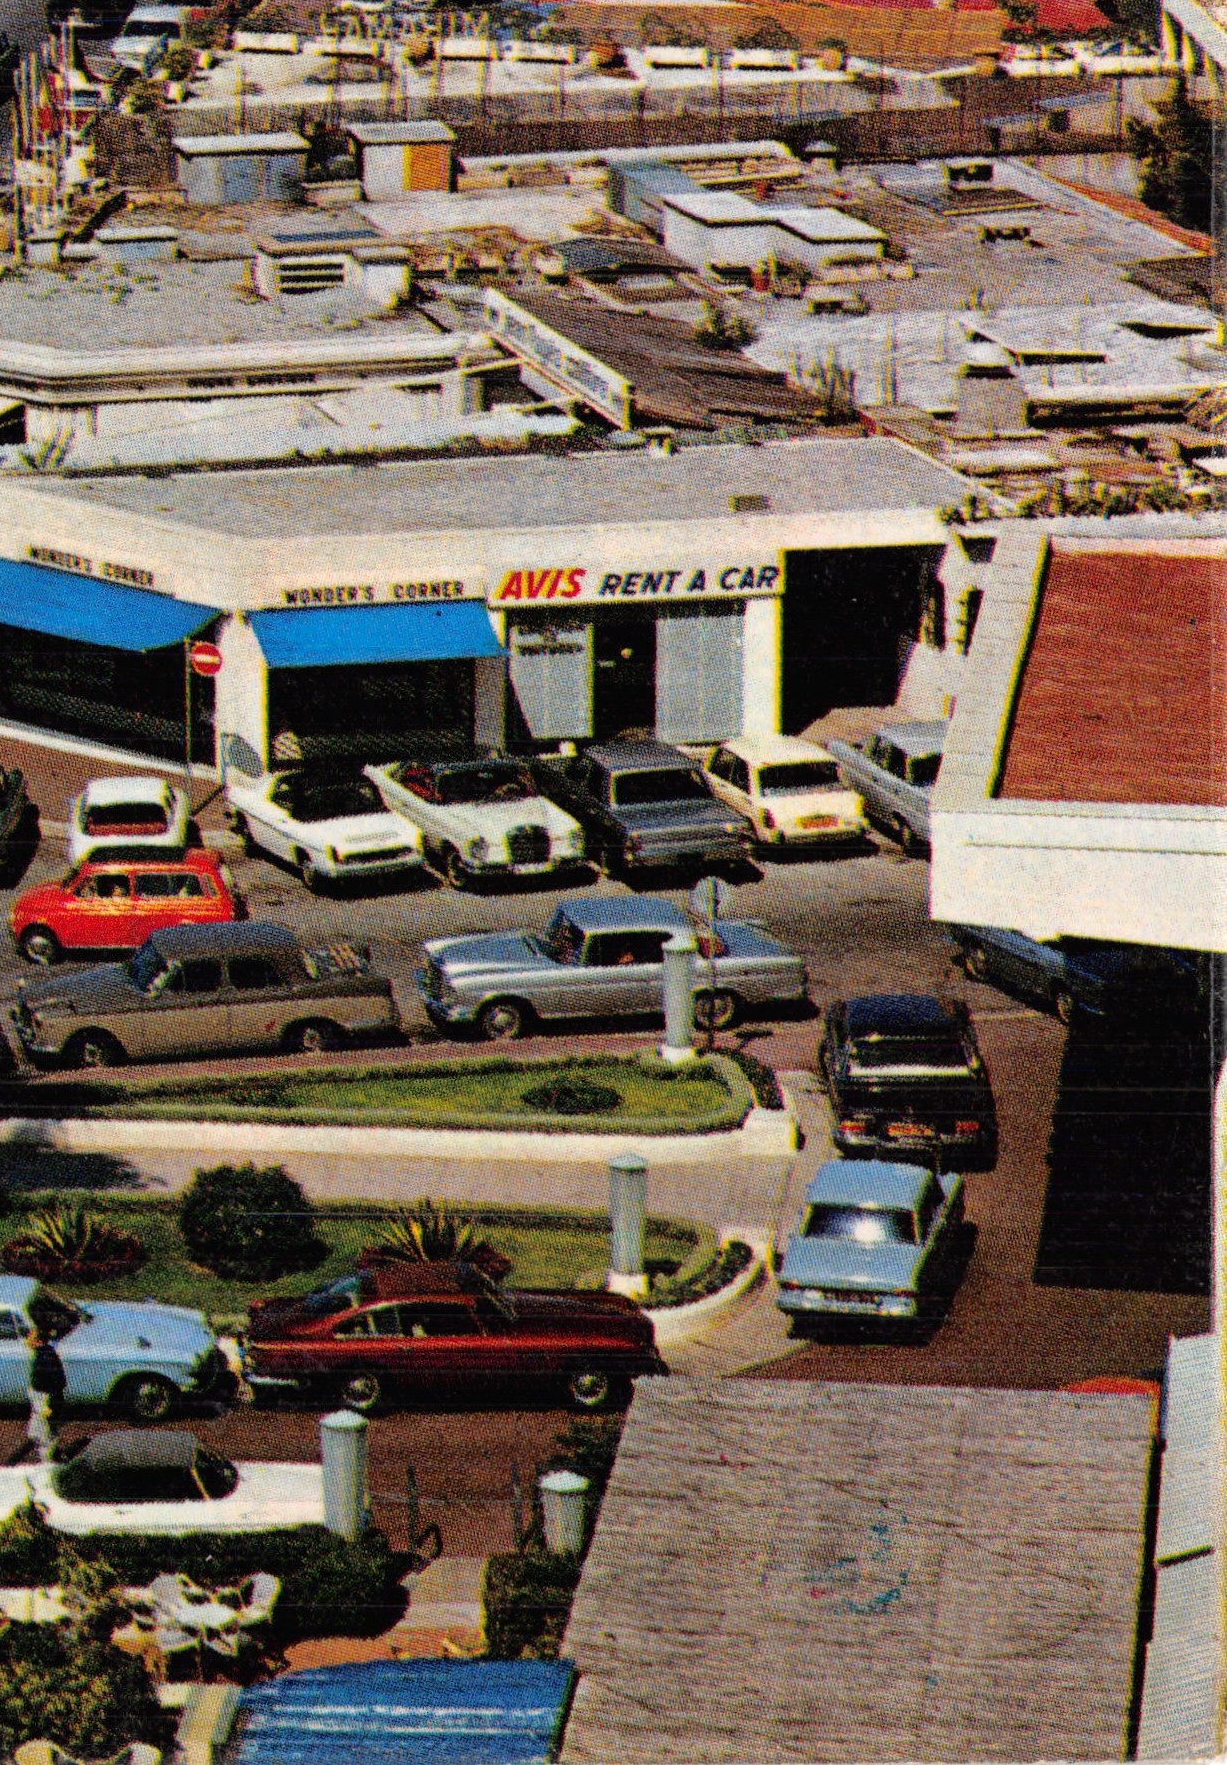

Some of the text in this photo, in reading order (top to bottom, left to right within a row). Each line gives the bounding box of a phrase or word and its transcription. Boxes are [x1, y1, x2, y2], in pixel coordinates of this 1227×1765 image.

[99, 561, 155, 587] CORNER
[493, 565, 780, 600] AVIS RENT A CAR
[281, 579, 464, 605] WONDER'S CORNER
